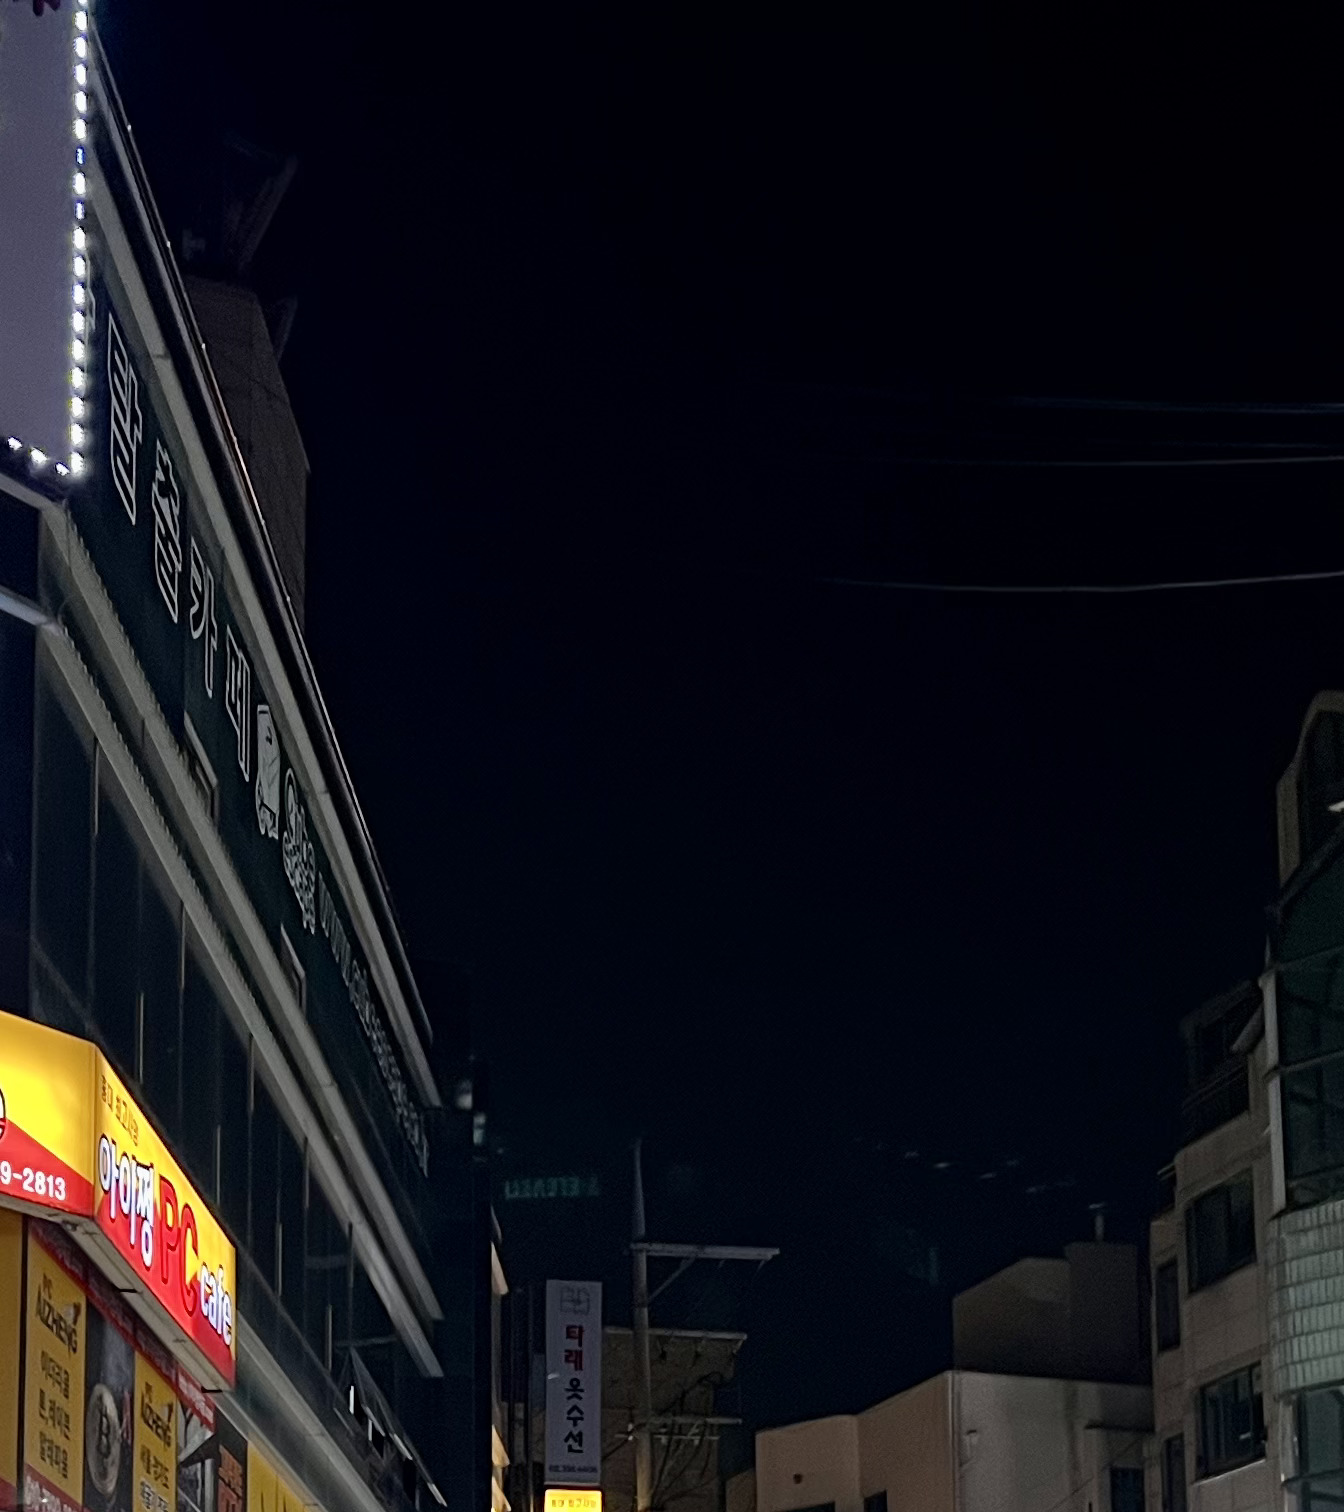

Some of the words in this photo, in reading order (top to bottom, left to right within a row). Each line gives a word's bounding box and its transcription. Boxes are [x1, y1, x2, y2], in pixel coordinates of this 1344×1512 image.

[157, 1174, 199, 1318] PC
[199, 1262, 234, 1348] cafe
[563, 1377, 585, 1454] 옷수선
